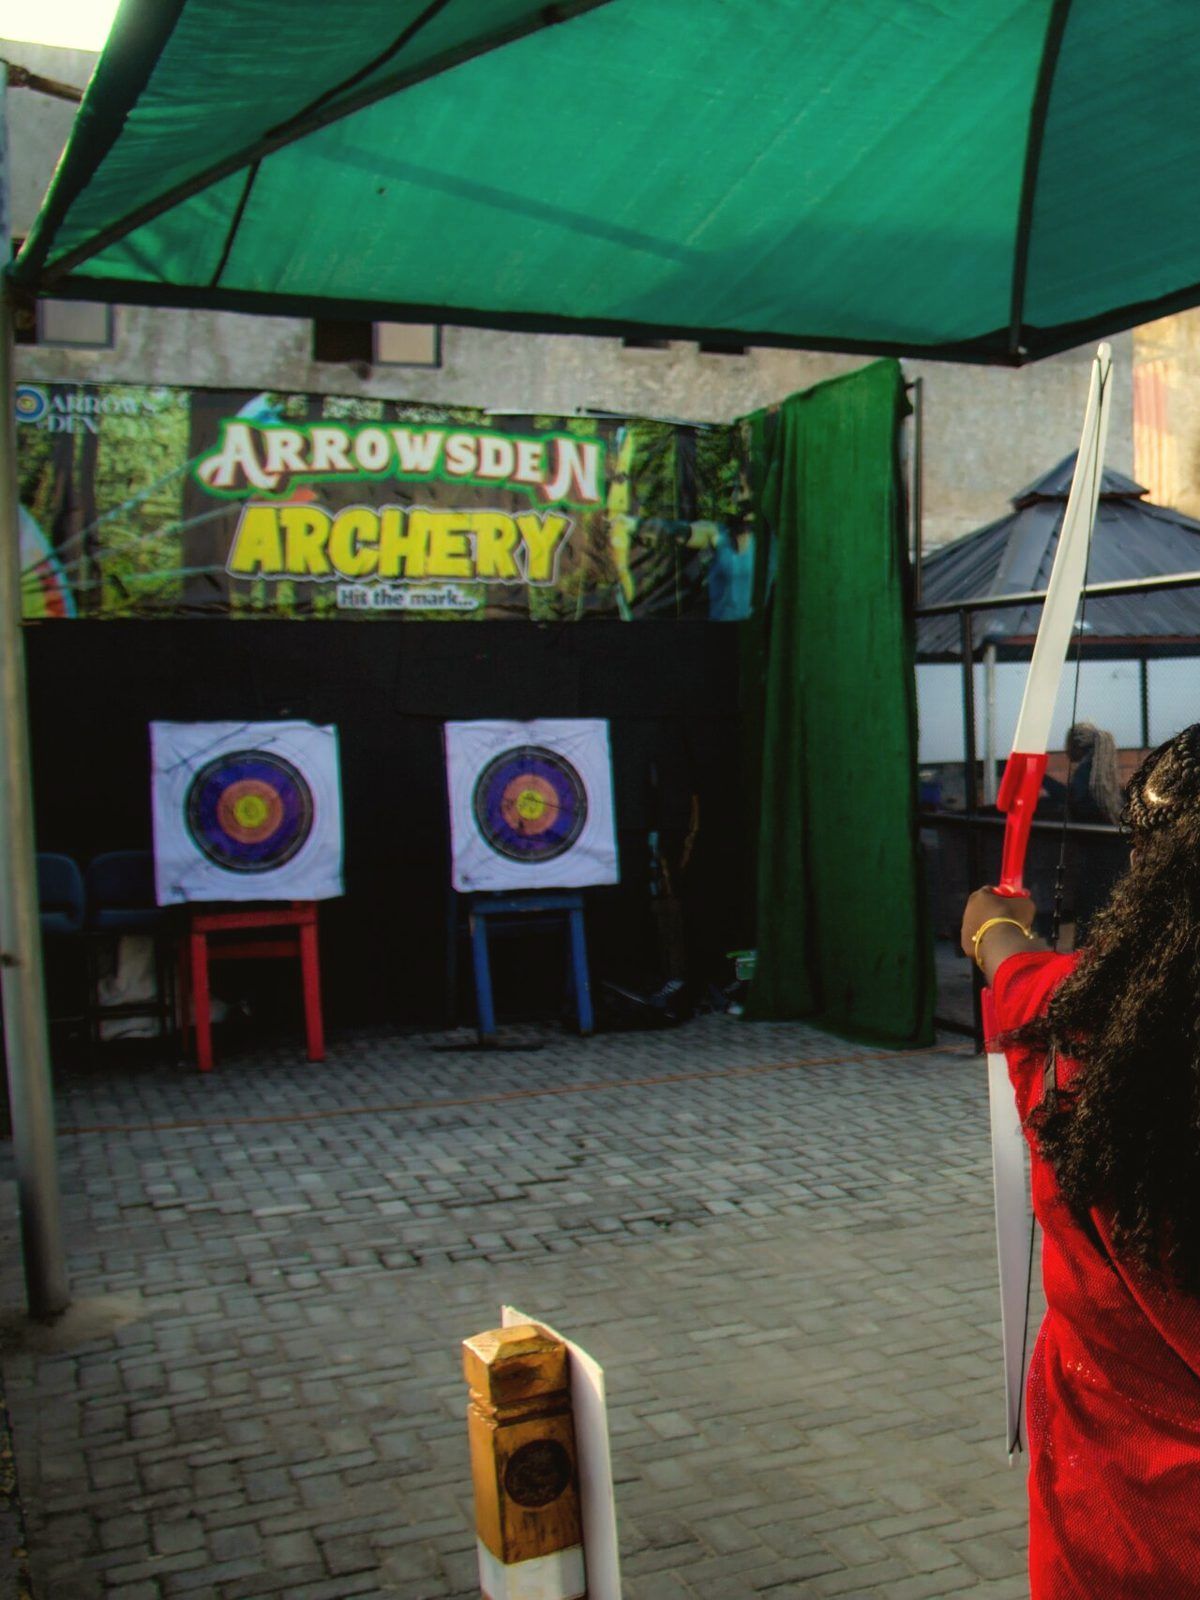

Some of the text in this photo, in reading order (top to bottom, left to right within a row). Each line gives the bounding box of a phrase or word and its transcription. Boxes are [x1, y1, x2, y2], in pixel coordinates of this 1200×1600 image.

[229, 506, 567, 581] ARCHERY
[340, 589, 367, 606] Hit
[374, 586, 404, 606] the
